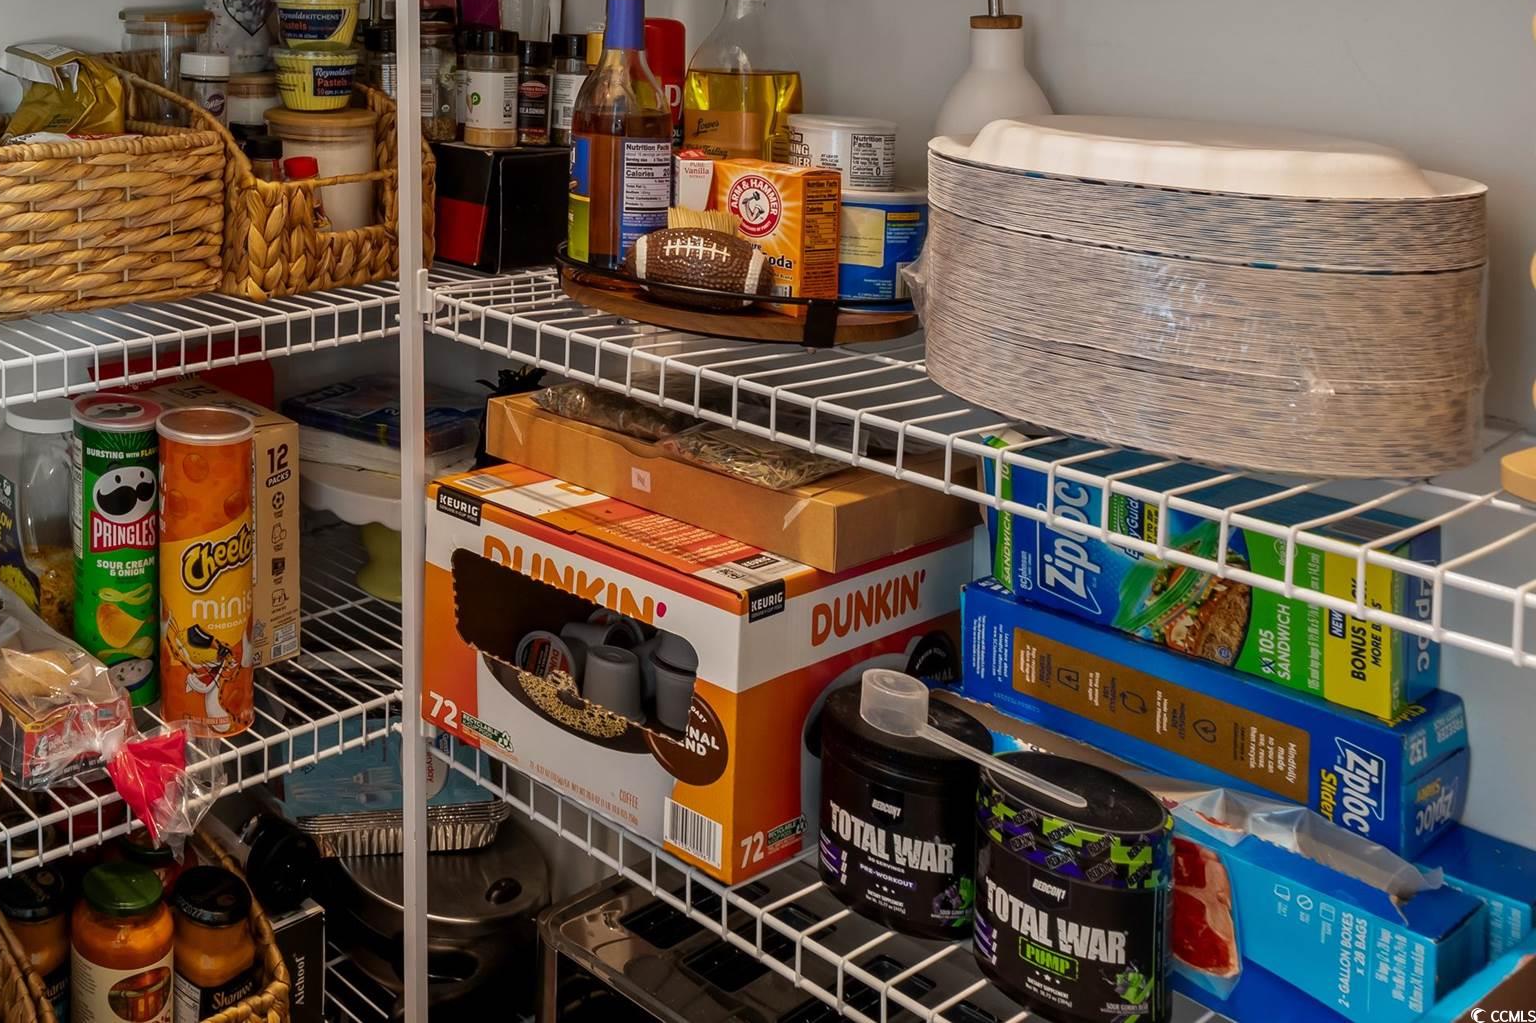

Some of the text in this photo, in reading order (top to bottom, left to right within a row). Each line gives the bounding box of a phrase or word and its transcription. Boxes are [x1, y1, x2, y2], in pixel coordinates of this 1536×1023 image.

[317, 78, 348, 87] Pastels
[853, 135, 883, 143] Nutrition
[685, 167, 710, 175] Vanilla
[731, 178, 778, 216] ARM HAMMER
[86, 448, 124, 459] BURSTING
[267, 444, 289, 474] 12
[268, 471, 290, 485] PACKS
[439, 493, 480, 517] KEURIG
[93, 517, 156, 549] PRINGLES
[1002, 511, 1012, 583] SANDWICH
[96, 557, 155, 570] SOUR CREAM
[118, 568, 145, 576] ONION
[183, 529, 253, 590] Cheeto
[751, 592, 784, 612] KEURIG
[811, 569, 926, 647] DUNKIN'
[1277, 604, 1291, 681] SANDWICH
[1350, 625, 1367, 681] BONUS
[1372, 638, 1383, 667] MORE
[429, 691, 458, 729] 72
[1277, 747, 1285, 771] made
[1287, 742, 1297, 785] Mindfully
[618, 788, 640, 810] COFFEE
[1320, 769, 1338, 823] Slider
[1334, 748, 1380, 835] Ziploc
[740, 831, 764, 869] 72
[830, 800, 890, 861] TOTAL
[893, 833, 954, 874] WAR
[860, 863, 914, 888] PRE-WORKOUT
[985, 876, 1126, 965] TOTAL WAR
[1342, 912, 1354, 948] BOXES
[1357, 919, 1367, 948] BAGS
[1025, 943, 1070, 975] PUMP
